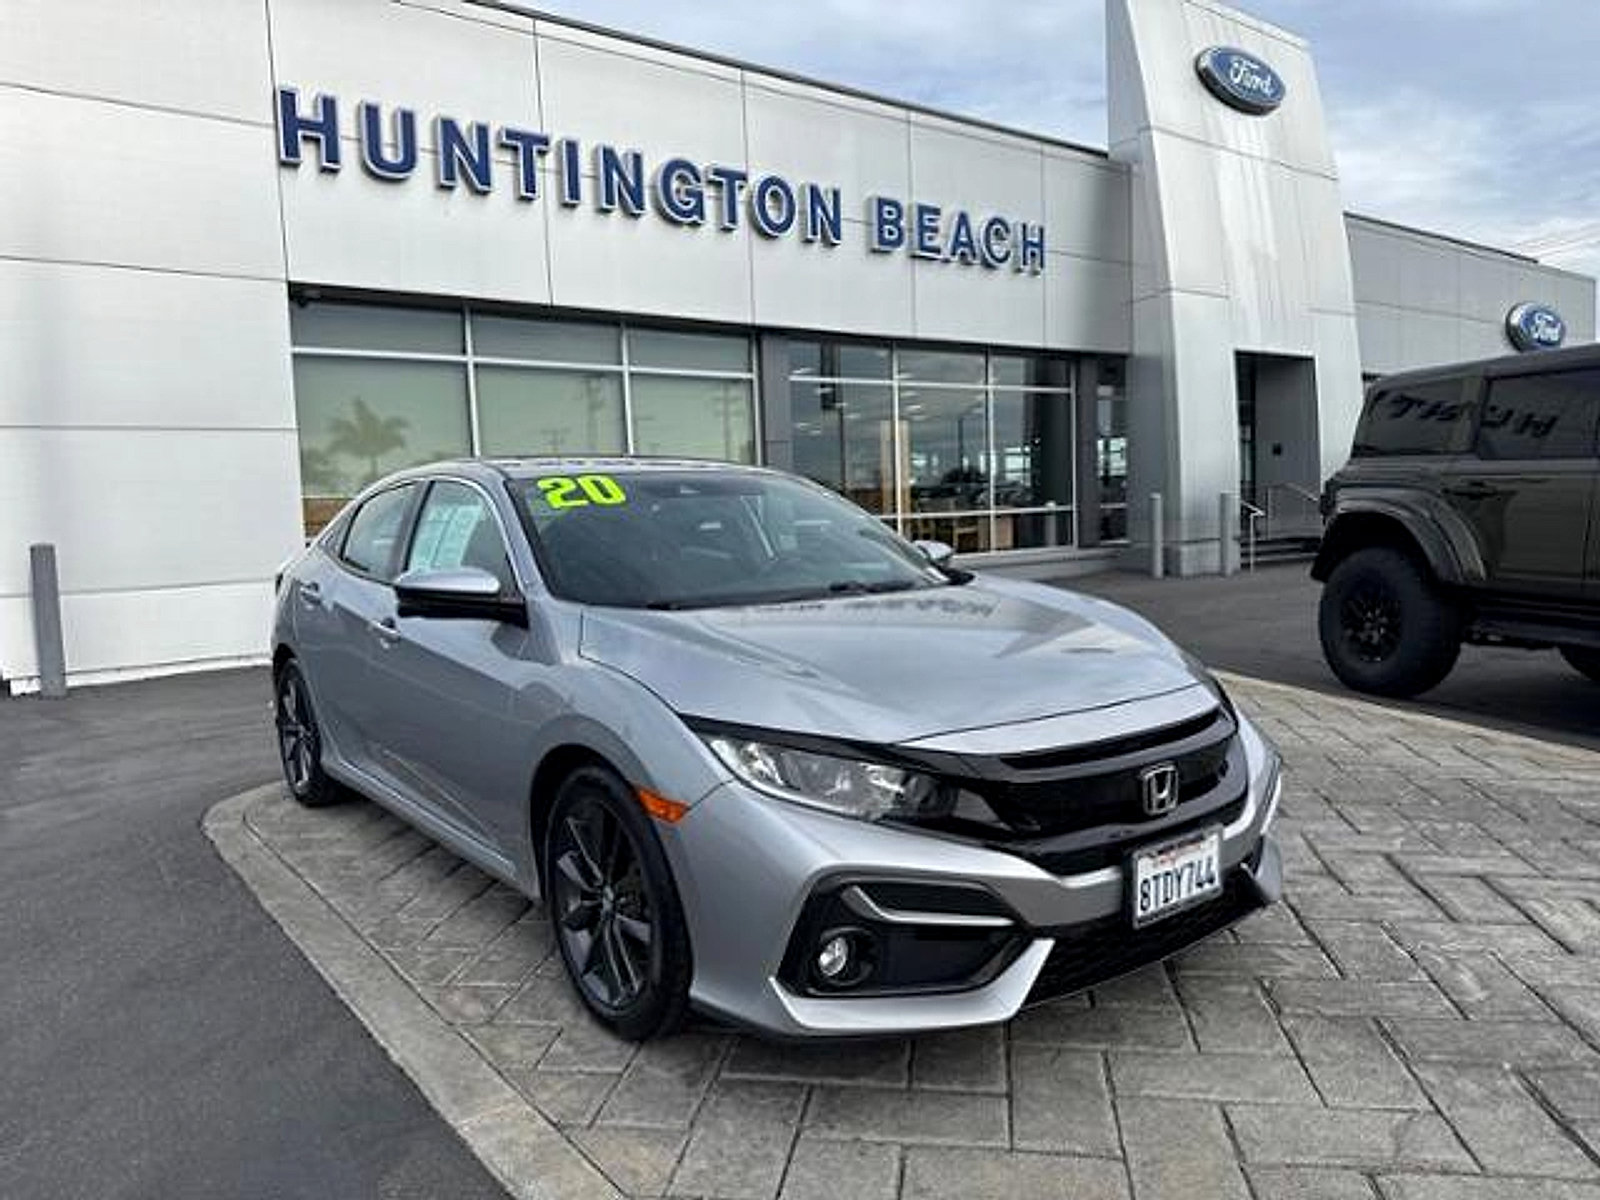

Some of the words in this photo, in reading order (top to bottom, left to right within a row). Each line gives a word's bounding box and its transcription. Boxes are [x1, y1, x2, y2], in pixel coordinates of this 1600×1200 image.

[1229, 56, 1276, 97] Ford
[279, 87, 843, 247] HUNTINGTON
[868, 196, 1045, 276] BEACH
[1531, 311, 1561, 342] Ford
[537, 474, 626, 509] 20
[1140, 856, 1215, 911] 8TDY744
